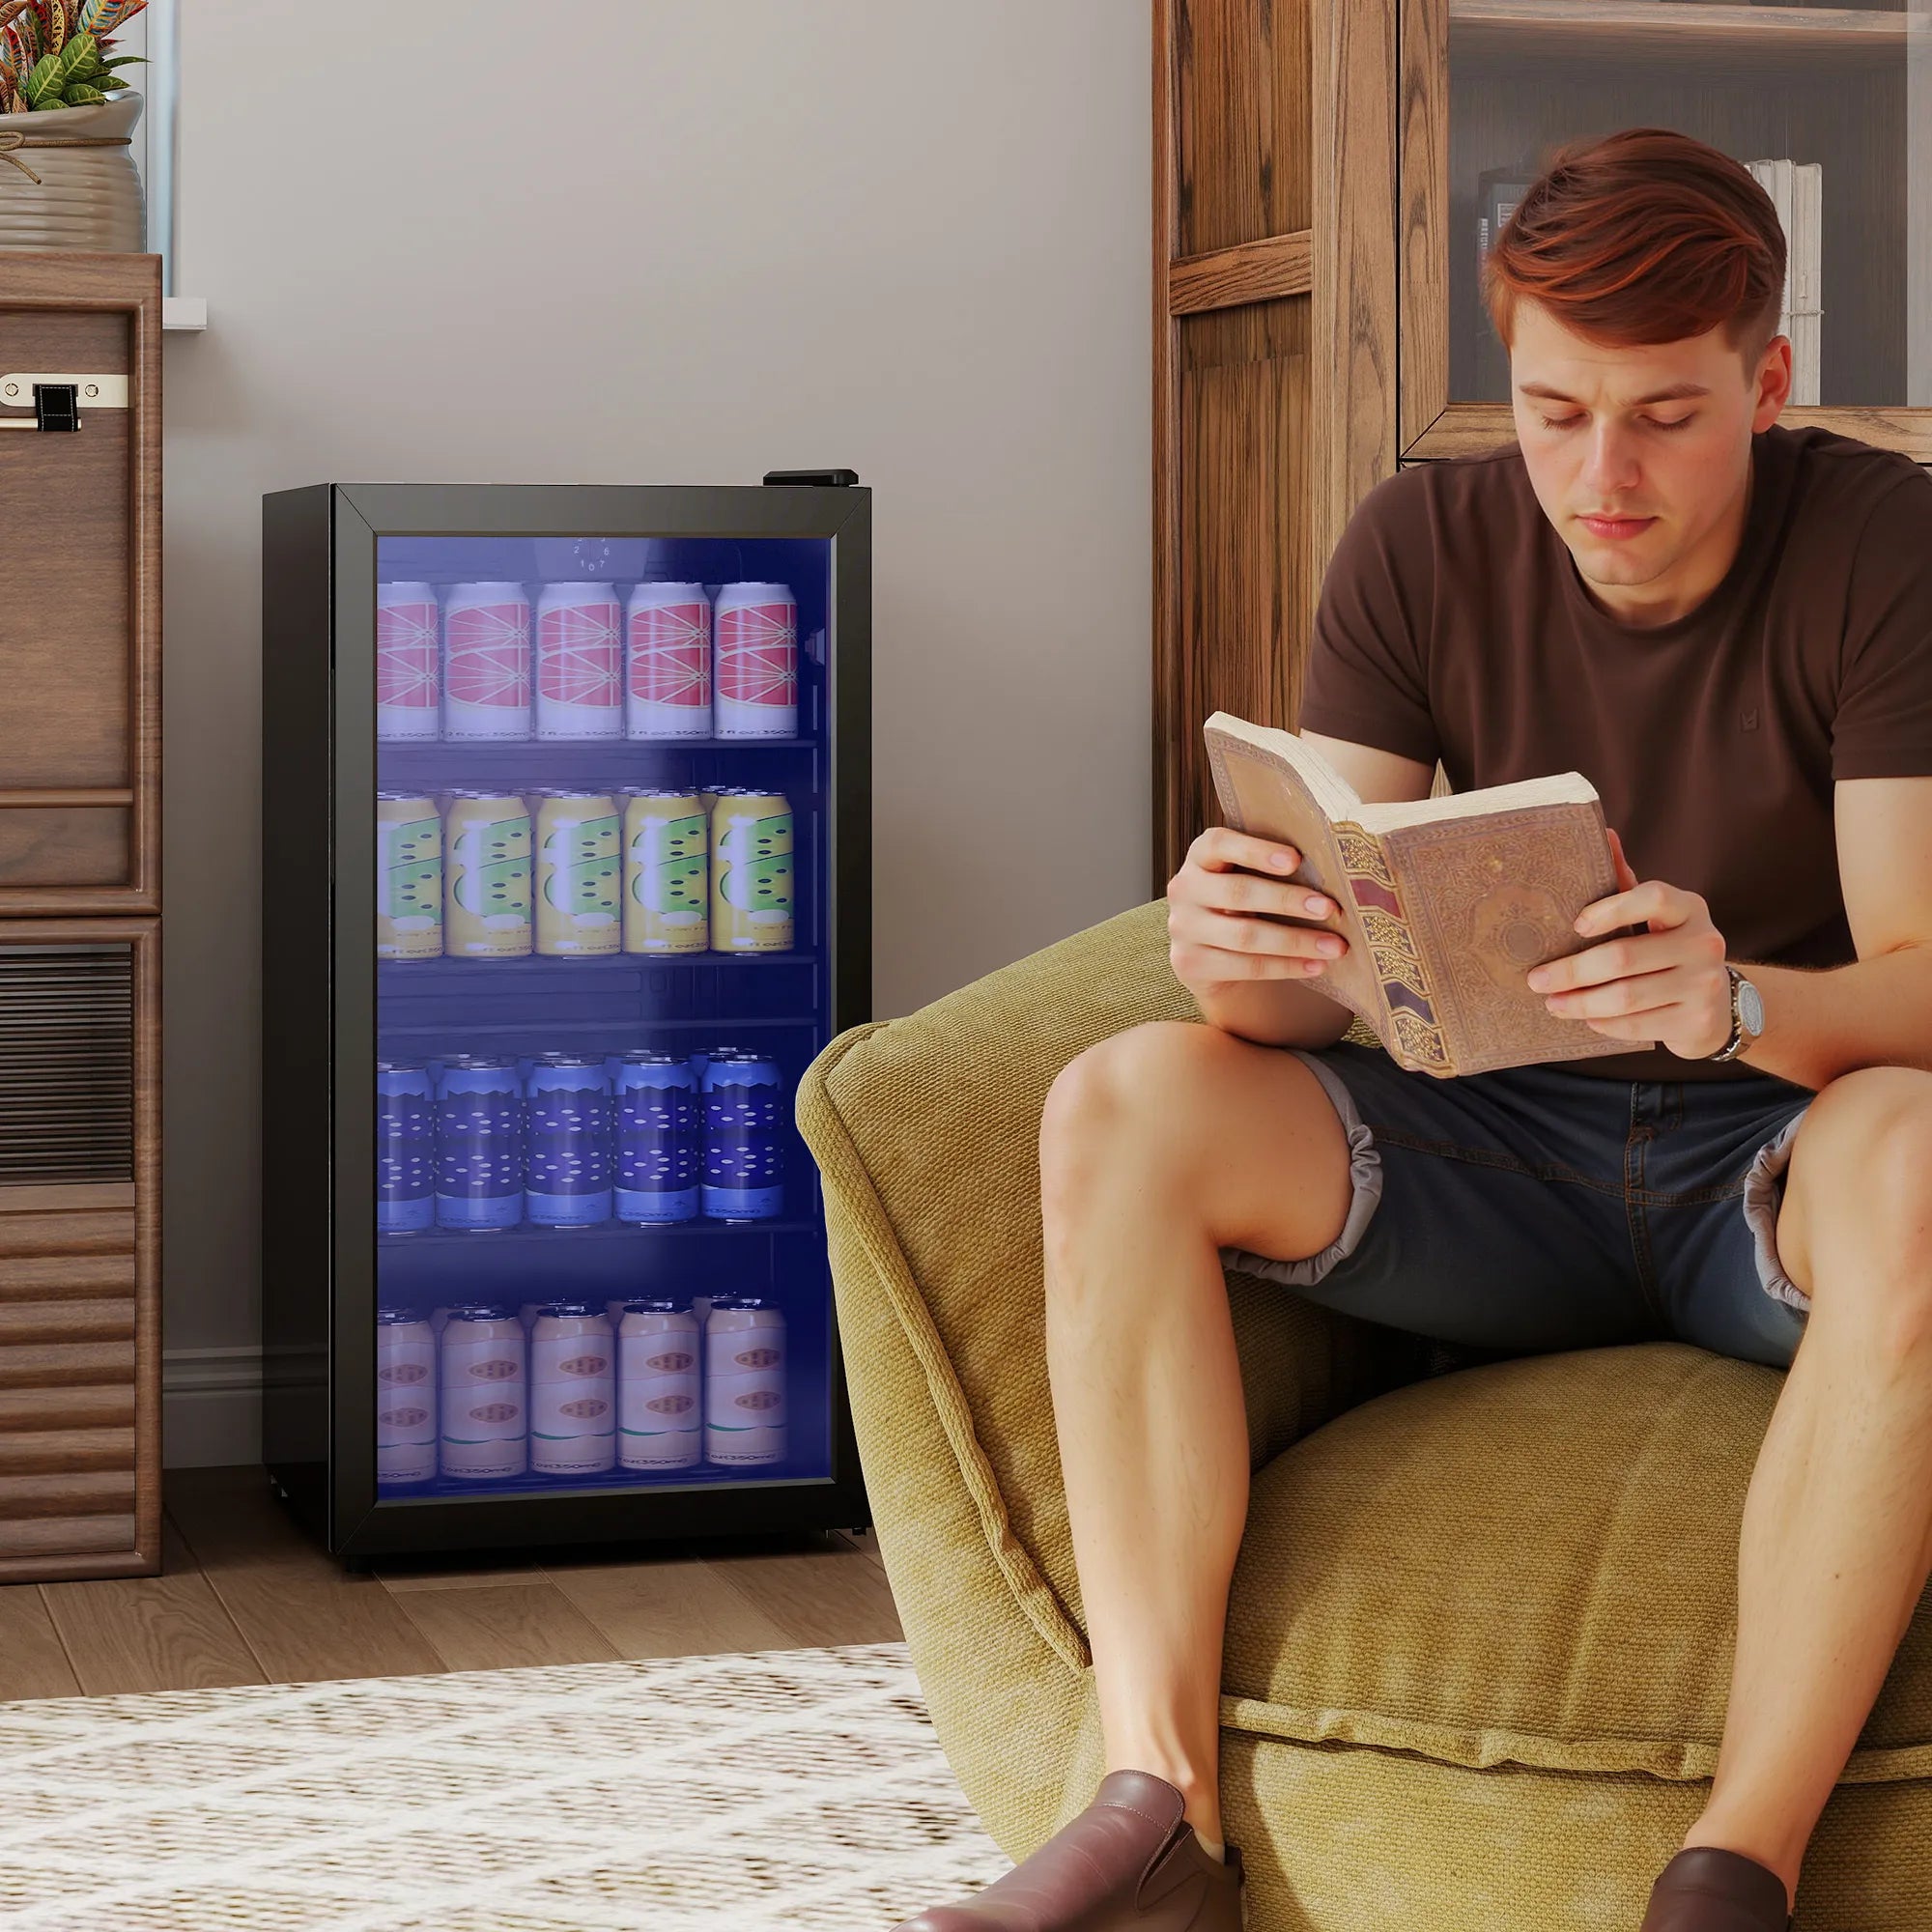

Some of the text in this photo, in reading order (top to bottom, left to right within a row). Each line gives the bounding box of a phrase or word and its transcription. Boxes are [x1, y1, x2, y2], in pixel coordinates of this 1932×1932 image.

[574, 545, 580, 554] 2
[603, 547, 610, 556] 6
[580, 558, 584, 568] 1
[588, 563, 595, 572] 0
[599, 558, 606, 569] 7
